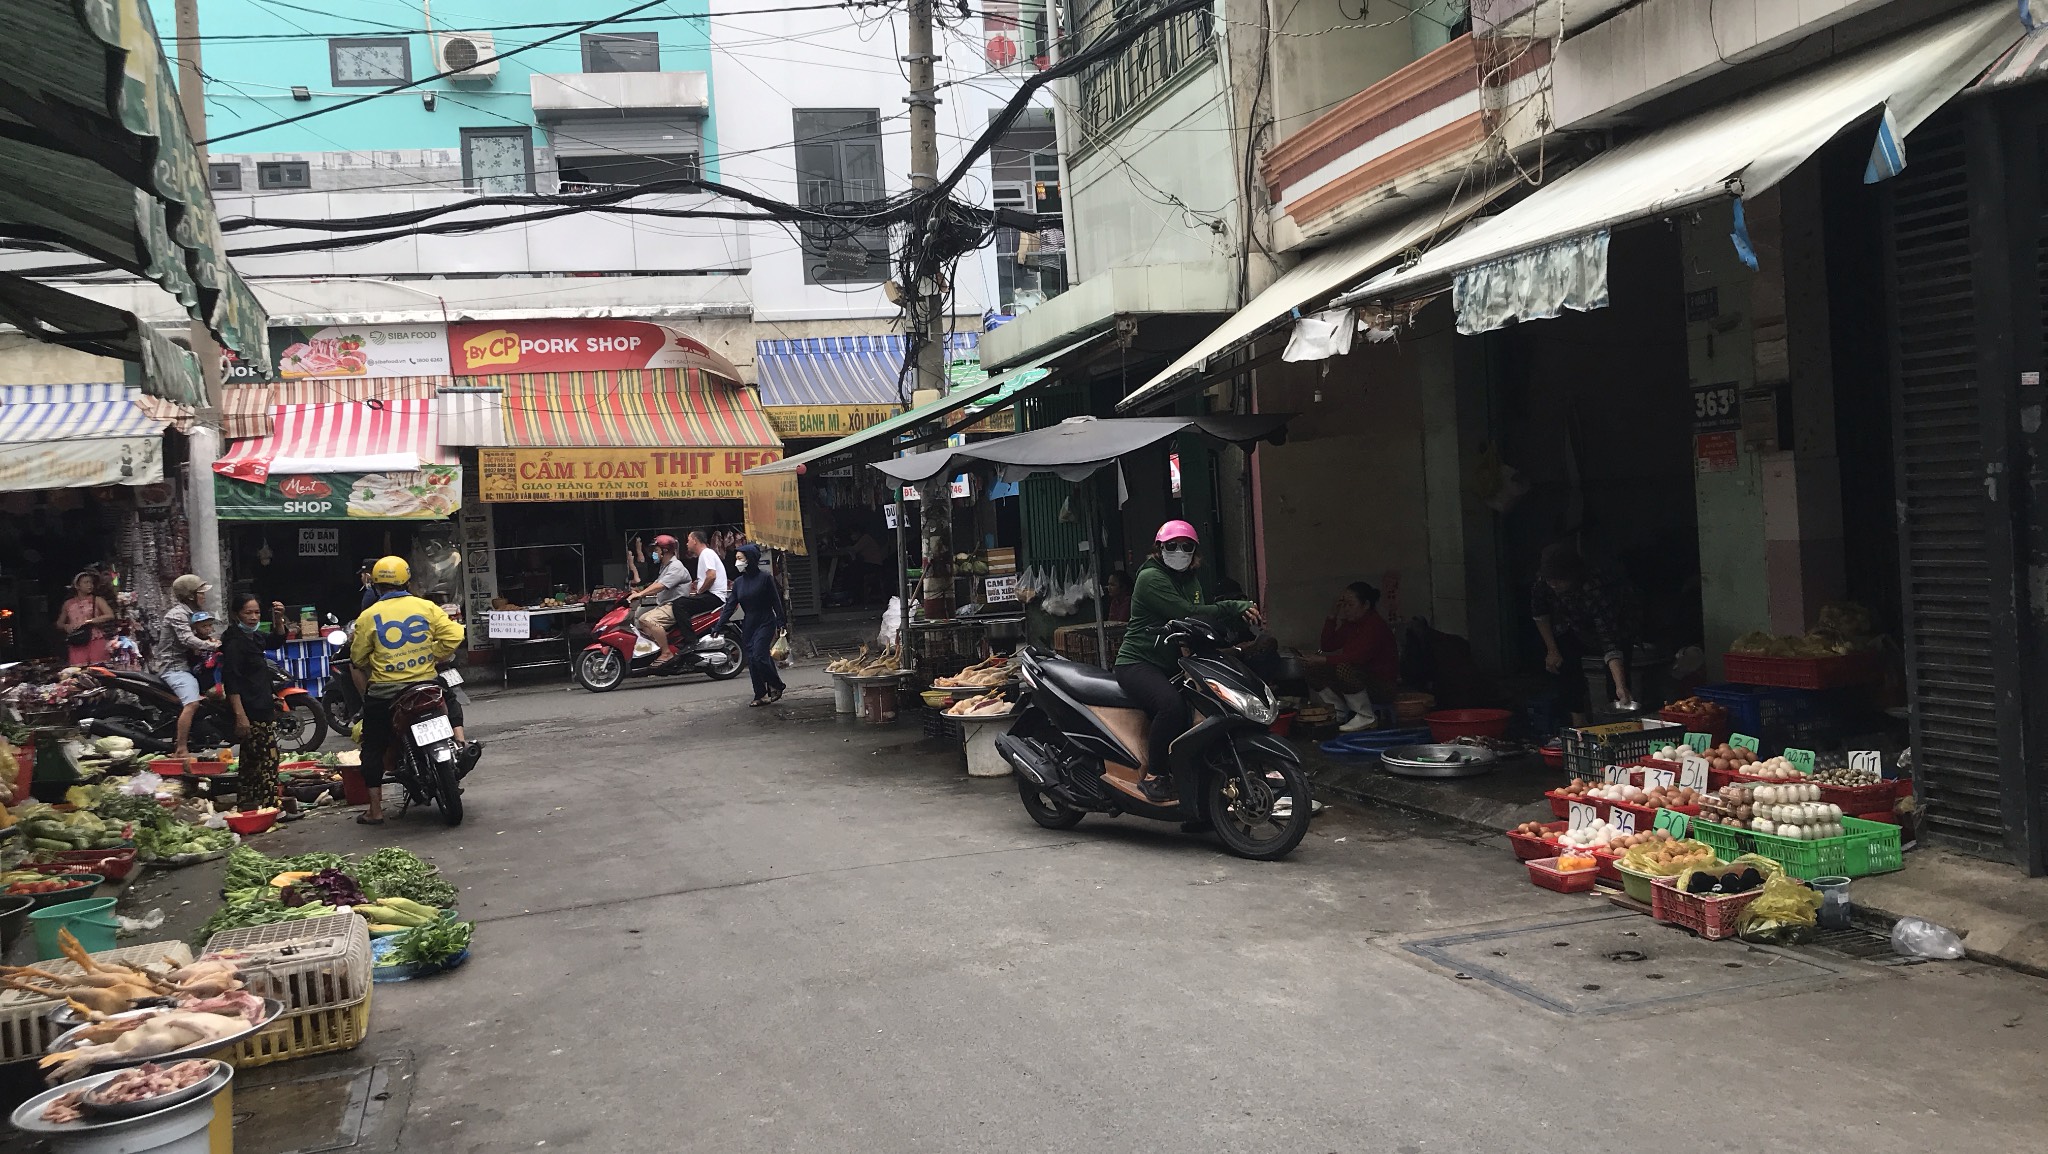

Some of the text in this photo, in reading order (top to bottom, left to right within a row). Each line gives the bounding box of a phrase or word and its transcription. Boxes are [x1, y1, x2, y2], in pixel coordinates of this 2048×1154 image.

[388, 331, 437, 340] SIBA FOOD
[489, 336, 516, 356] CP
[521, 337, 580, 355] PORK
[586, 336, 642, 352] SHOP
[799, 409, 826, 433] BÁNH
[828, 409, 840, 432] MÌ
[519, 451, 576, 479] CẨM
[583, 460, 648, 479] LOAN
[650, 451, 717, 480] THỊT
[521, 482, 553, 490] GIAO
[698, 489, 714, 497] HEO
[715, 489, 736, 498] QUAY
[283, 501, 333, 513] SHOP
[987, 579, 1004, 588] CAM
[373, 613, 430, 650] be
[1685, 760, 1704, 790] 34
[1615, 809, 1634, 836] 36
[1656, 811, 1685, 840] 30
